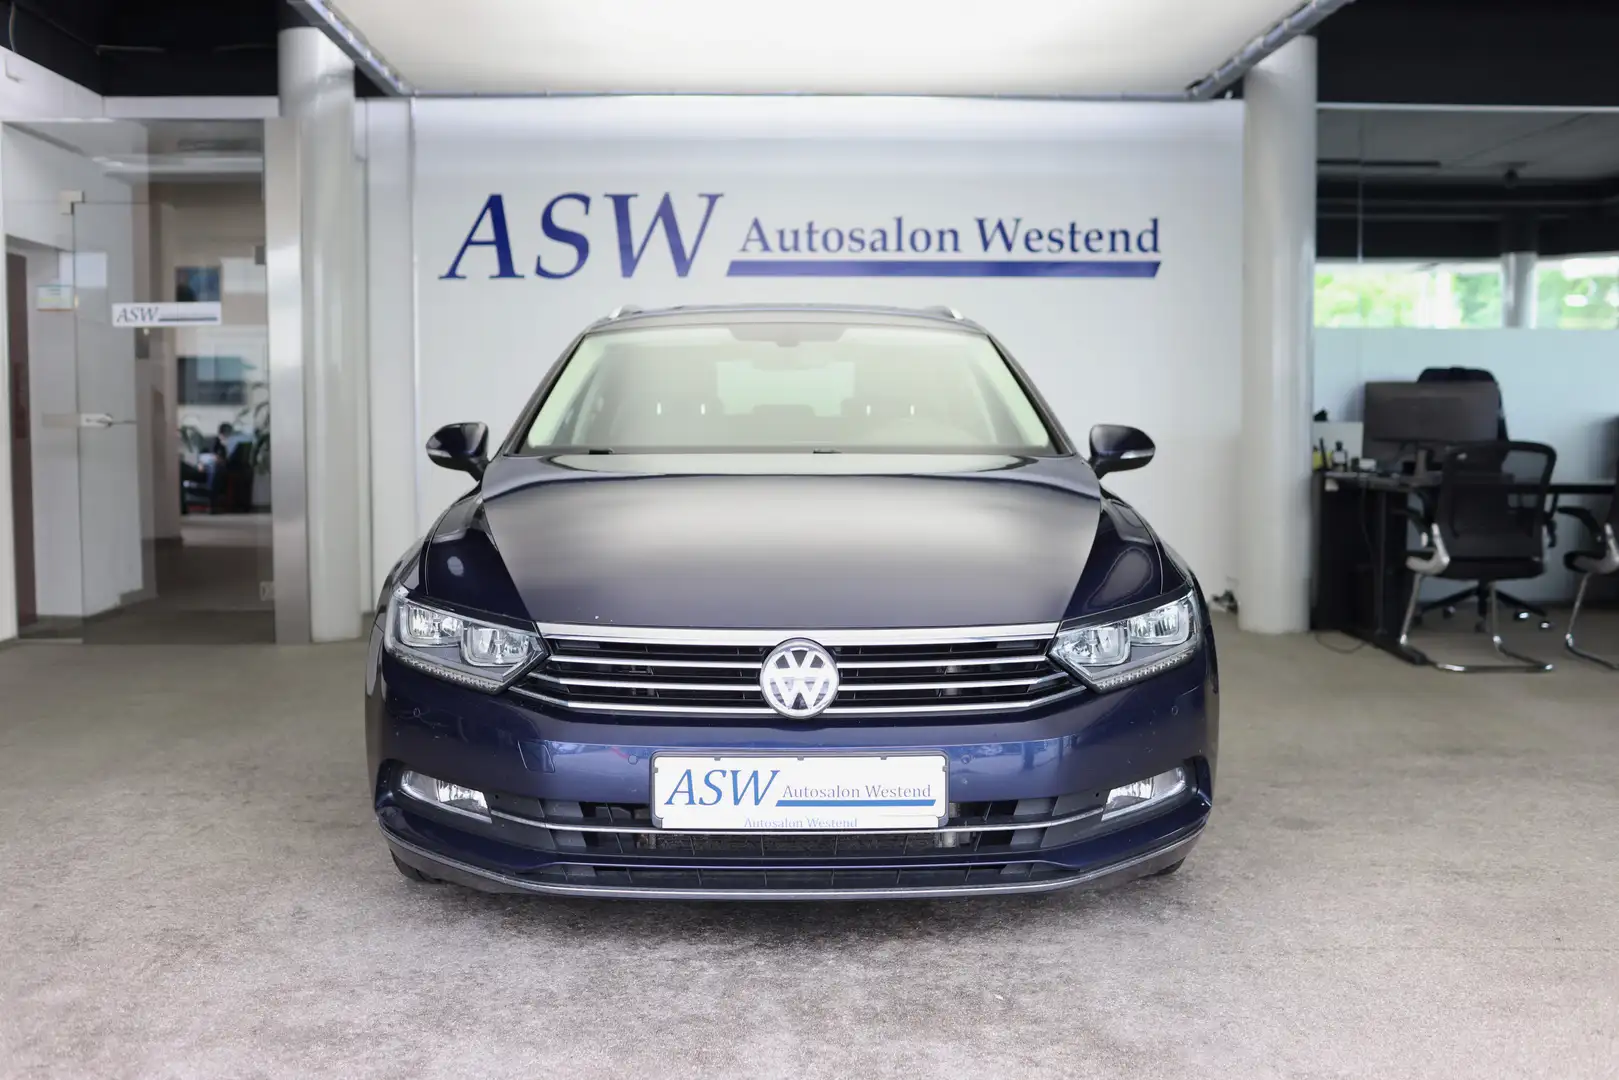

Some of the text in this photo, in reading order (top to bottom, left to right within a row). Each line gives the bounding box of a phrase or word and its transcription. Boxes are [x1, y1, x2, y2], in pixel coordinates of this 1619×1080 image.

[438, 192, 1161, 280] ASW Autosalon Westend
[116, 305, 159, 323] ASW
[663, 768, 932, 808] ASW Autosalon Westend
[743, 816, 858, 828] Autosalon Westend
